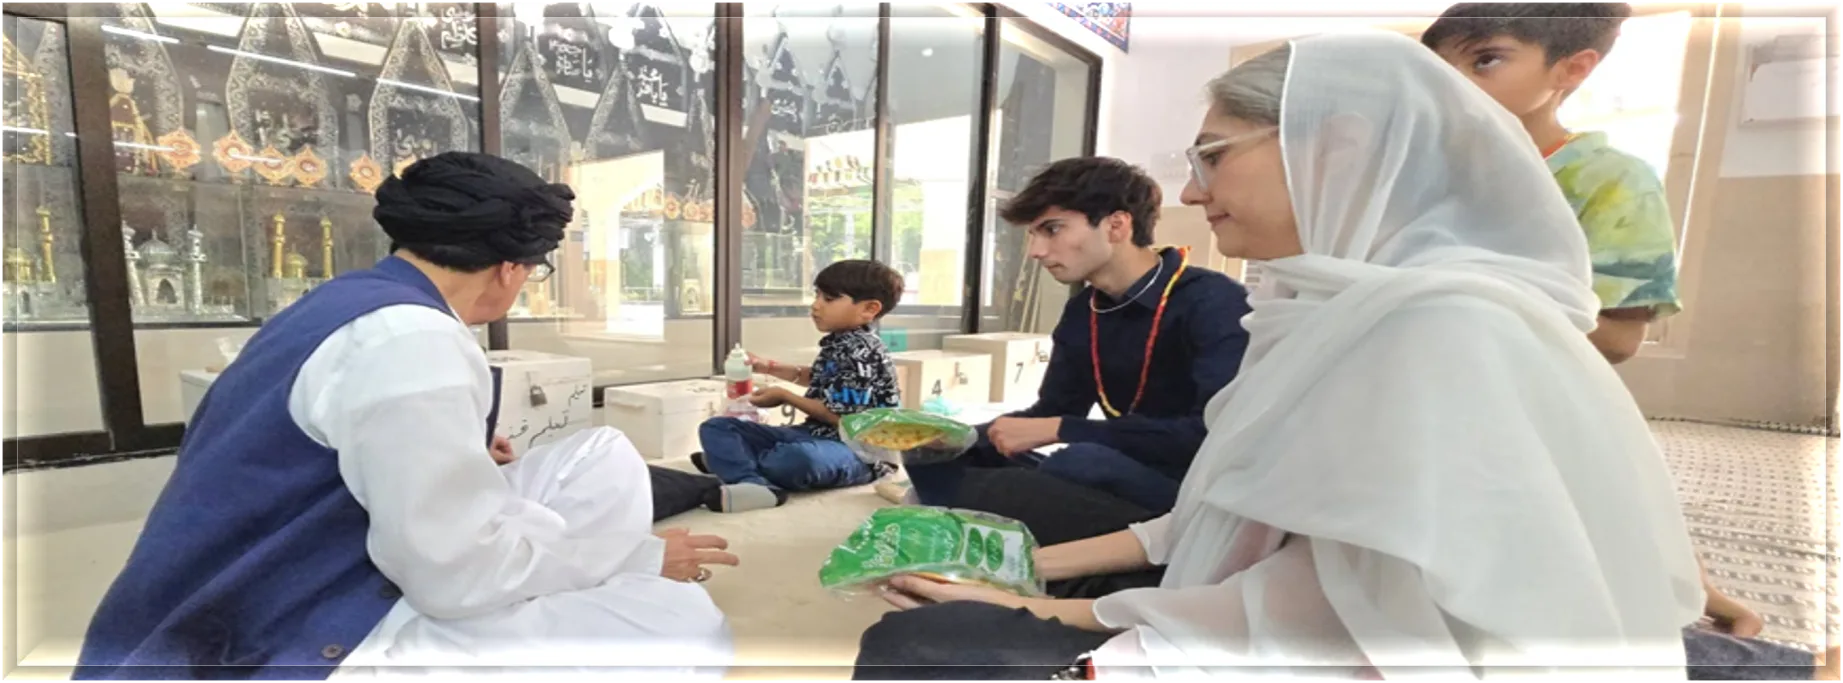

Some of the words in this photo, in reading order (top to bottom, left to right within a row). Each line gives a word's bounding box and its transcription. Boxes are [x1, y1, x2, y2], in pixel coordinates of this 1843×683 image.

[1015, 361, 1024, 384] 7
[931, 379, 942, 395] 4
[781, 403, 796, 426] 9
